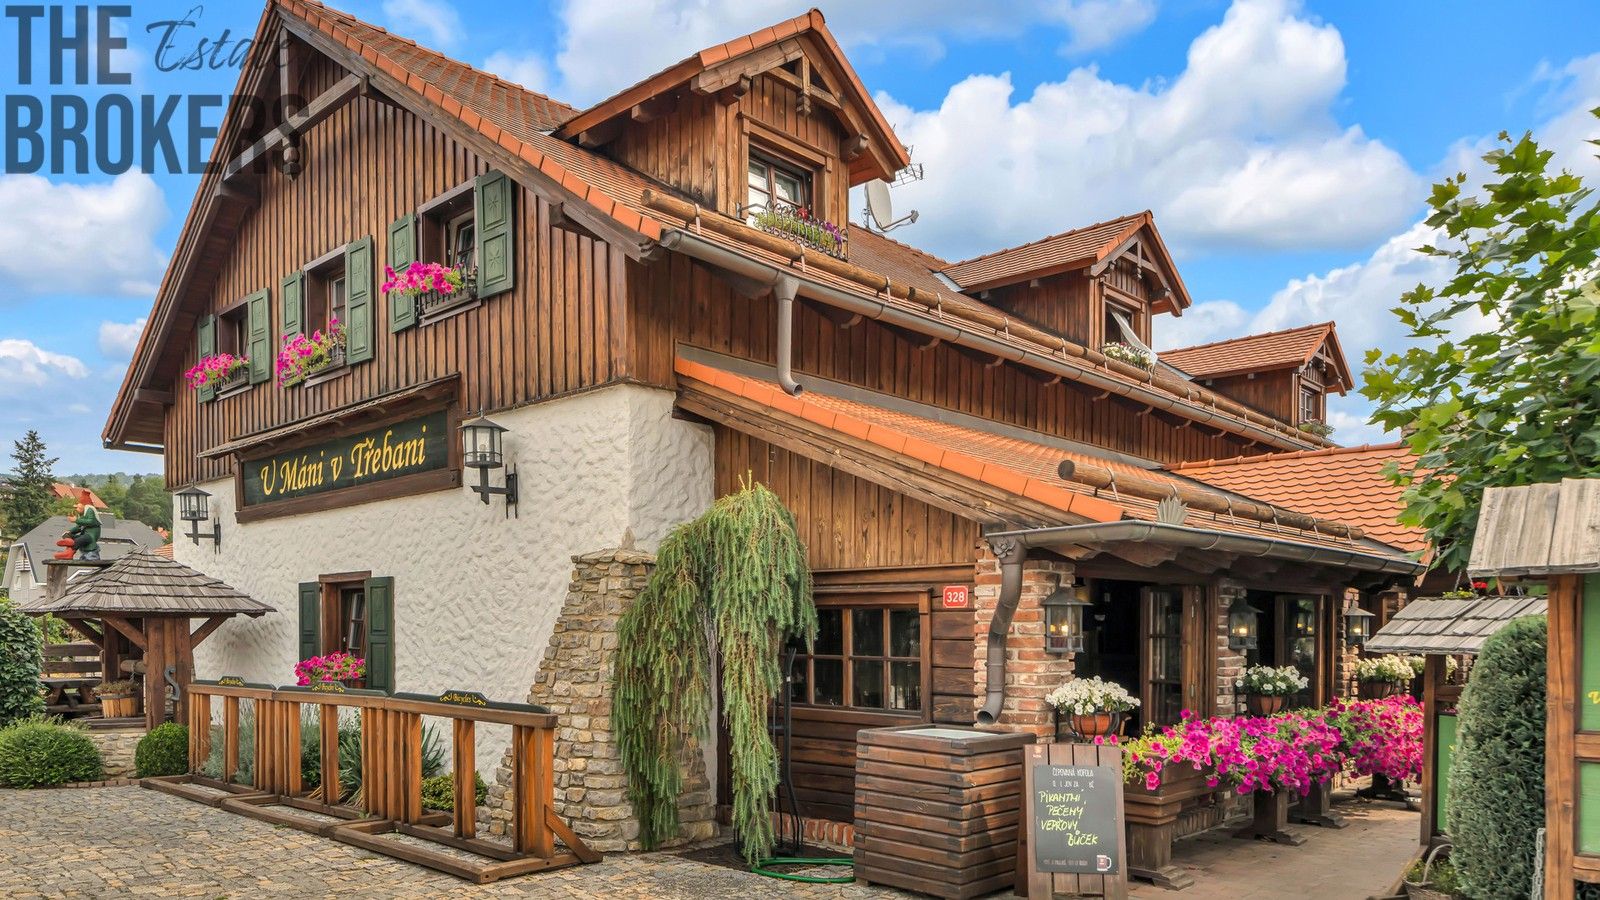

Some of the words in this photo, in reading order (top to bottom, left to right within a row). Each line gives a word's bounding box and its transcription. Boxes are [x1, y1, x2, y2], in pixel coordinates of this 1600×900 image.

[260, 459, 276, 496] U
[279, 450, 324, 495] Máni
[331, 455, 343, 482] v
[351, 424, 427, 479] Třebani
[946, 591, 965, 603] 328
